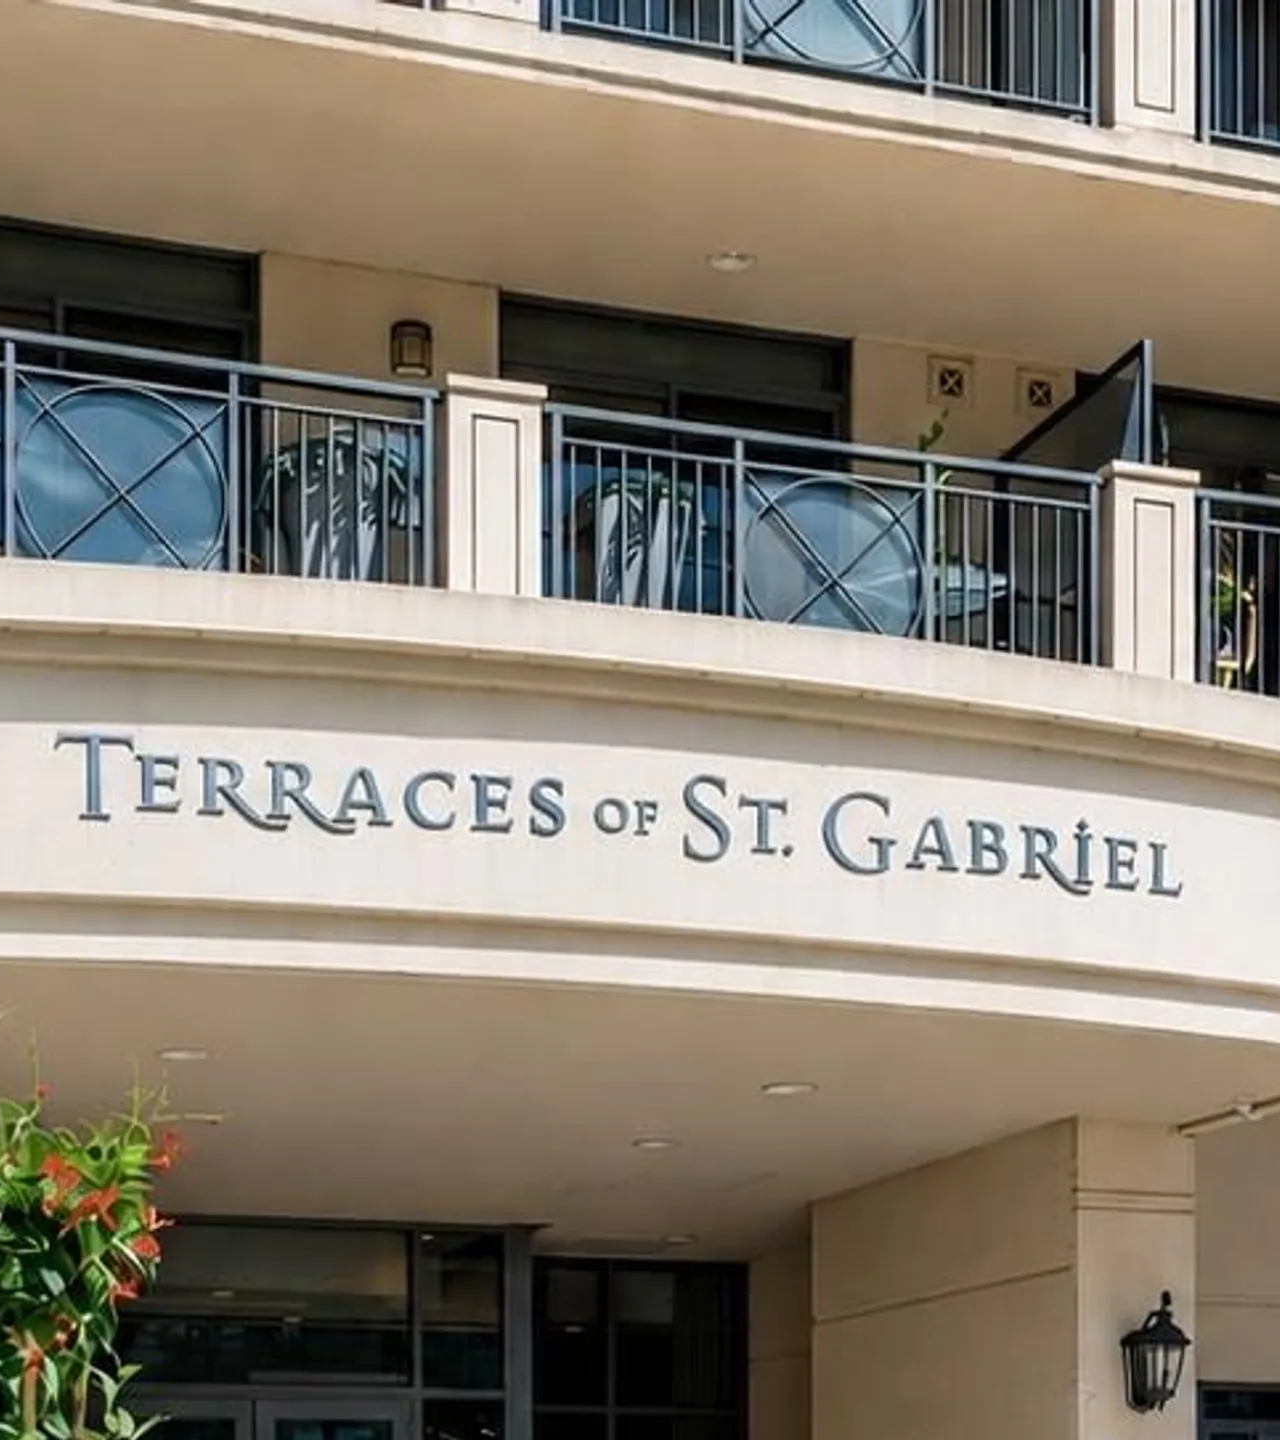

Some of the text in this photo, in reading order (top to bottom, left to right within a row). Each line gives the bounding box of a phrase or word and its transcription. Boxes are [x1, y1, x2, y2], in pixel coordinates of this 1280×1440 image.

[54, 731, 567, 837] TERRACES
[593, 797, 658, 836] OF
[682, 774, 794, 862] ST.
